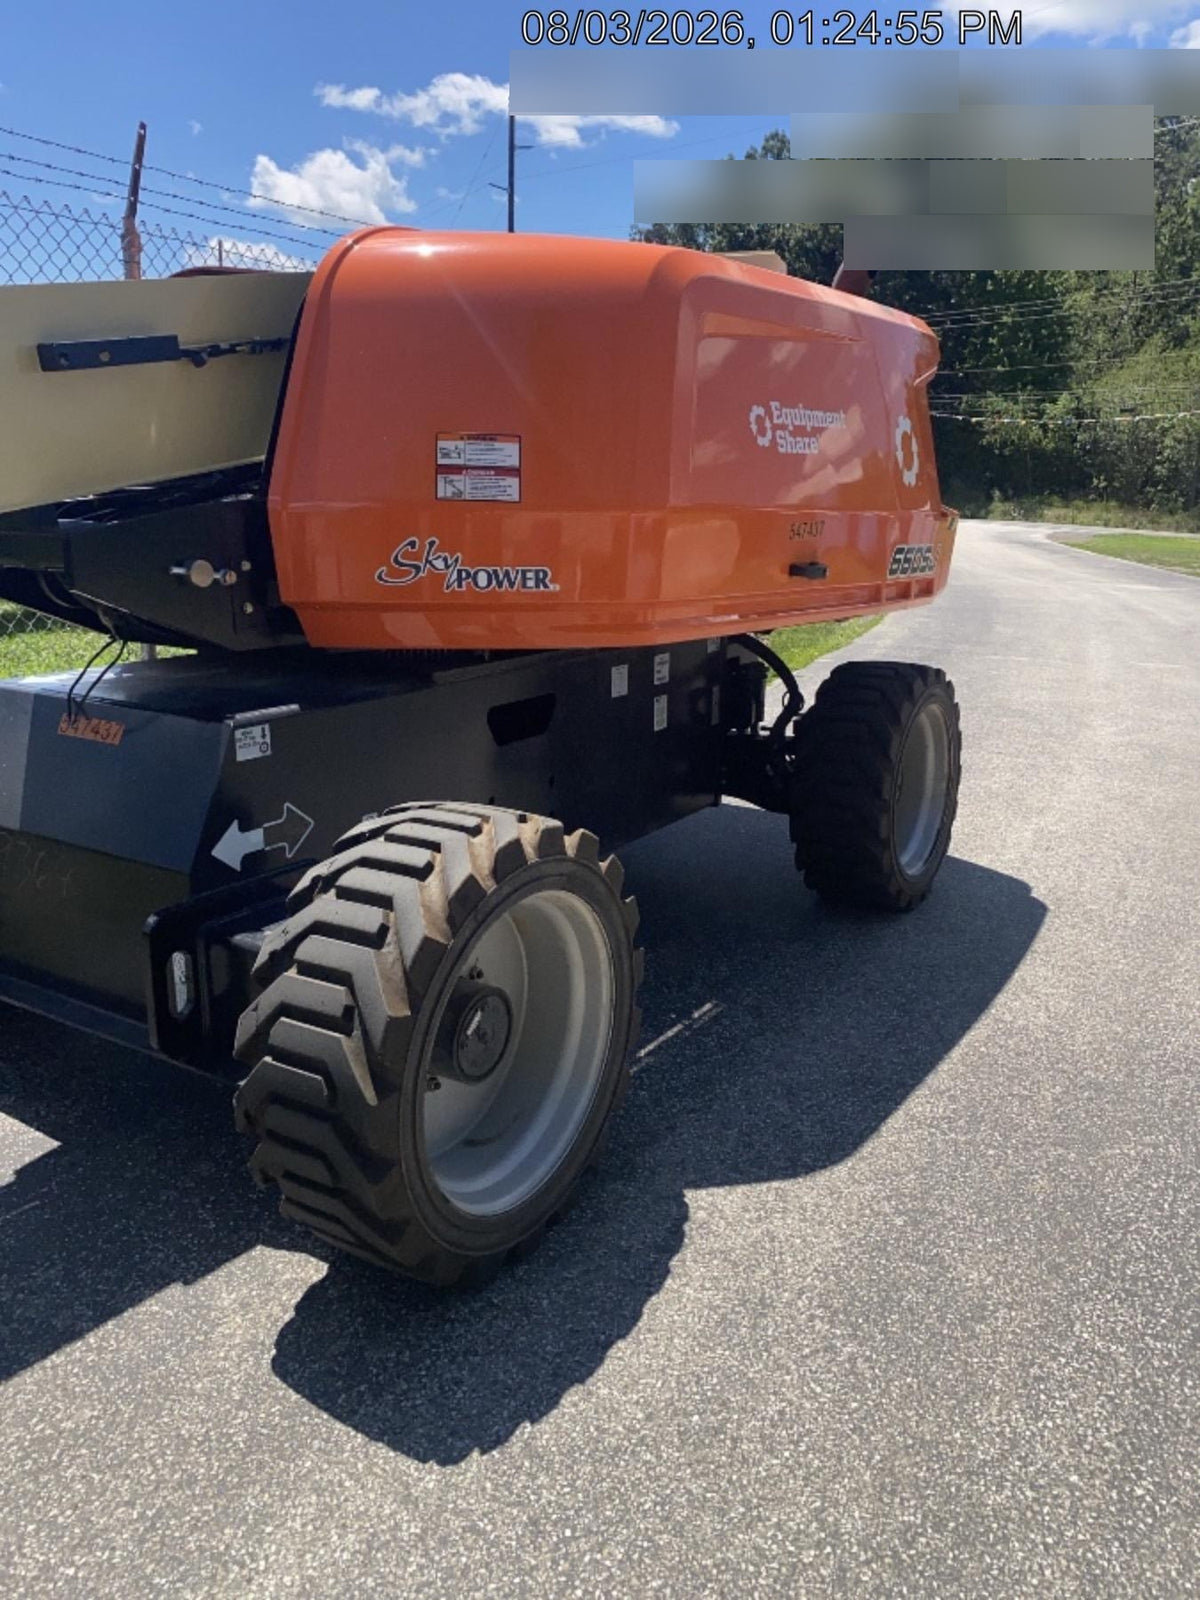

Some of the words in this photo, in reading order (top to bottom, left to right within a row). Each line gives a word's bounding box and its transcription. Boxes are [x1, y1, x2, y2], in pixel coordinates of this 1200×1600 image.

[769, 401, 846, 432] Equipment
[776, 430, 819, 454] Share
[376, 537, 461, 592] Sky
[454, 566, 553, 592] POWER
